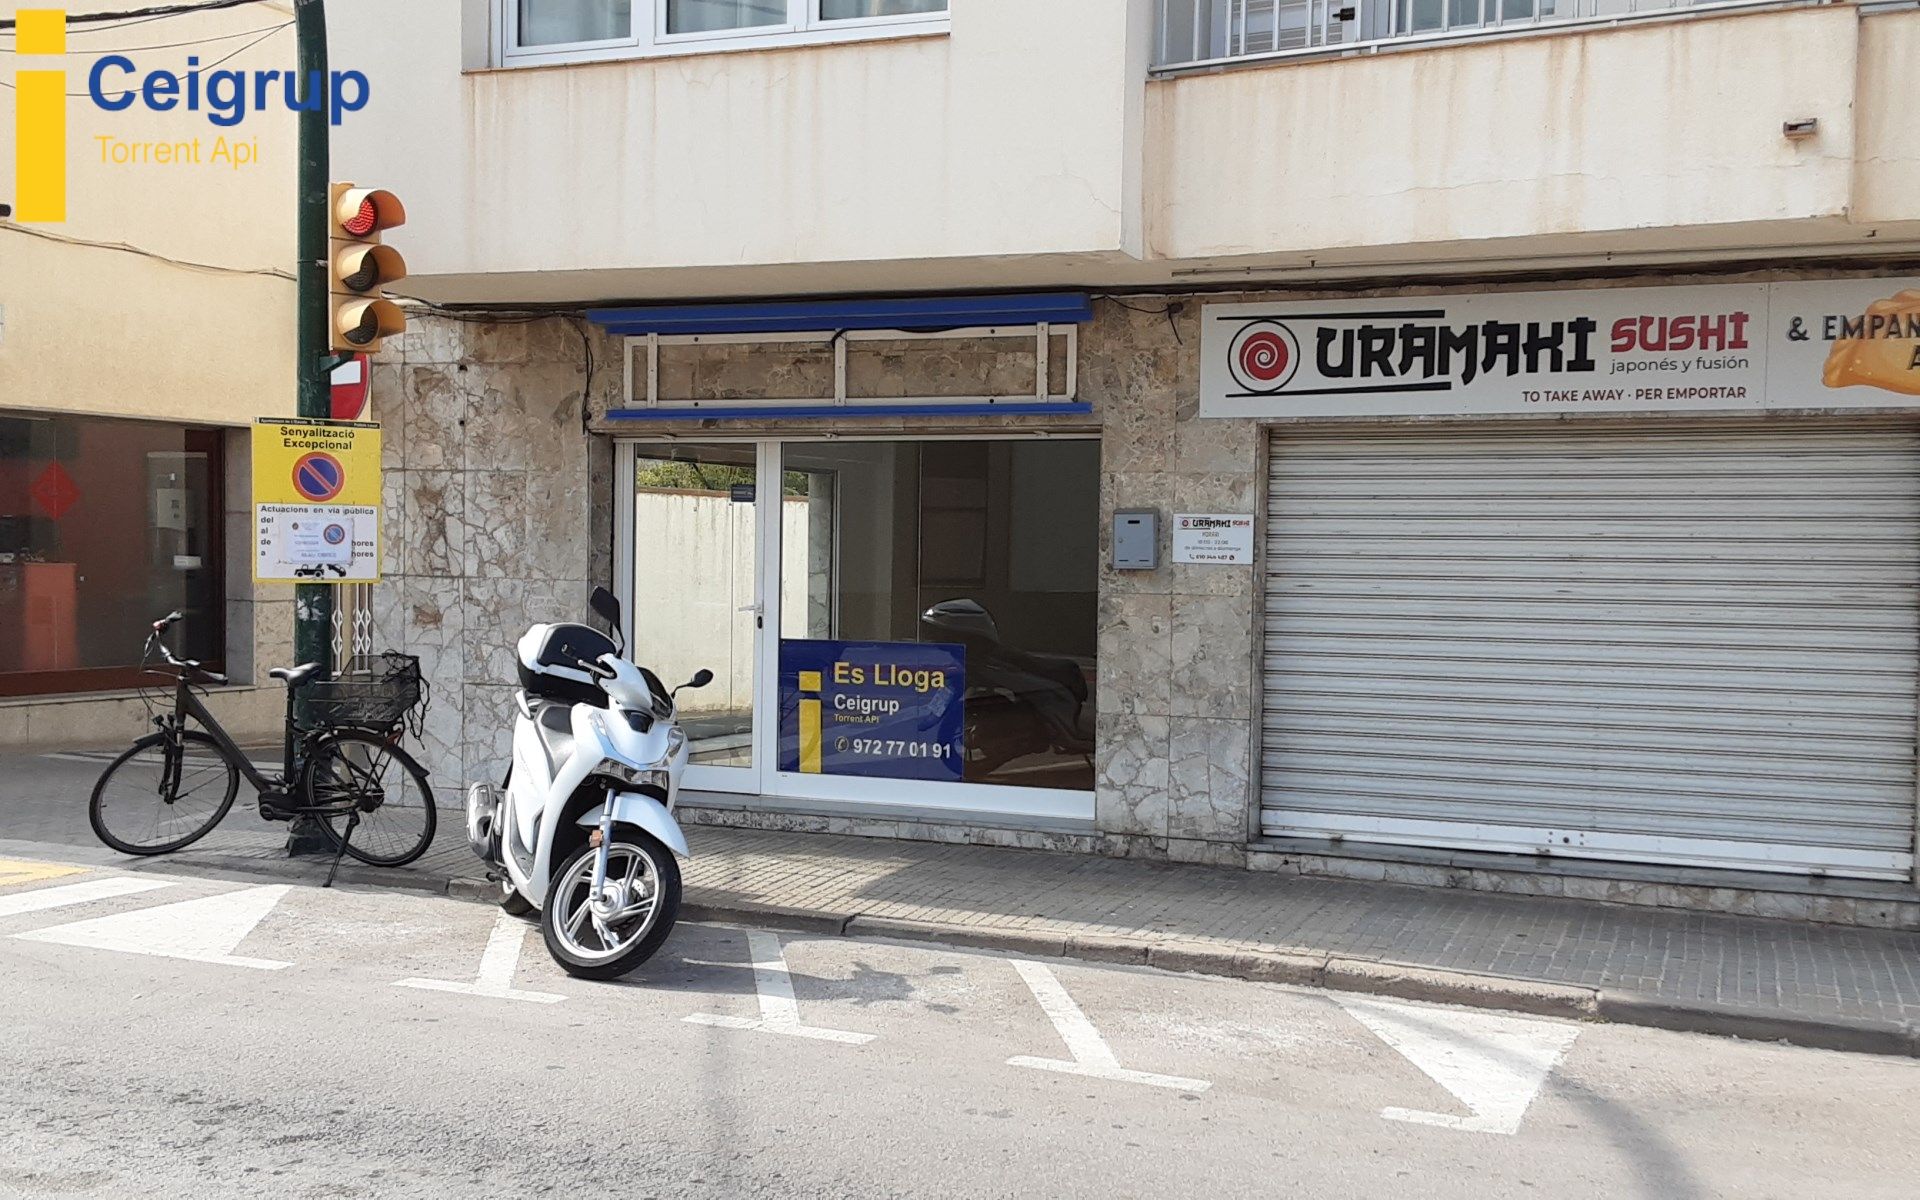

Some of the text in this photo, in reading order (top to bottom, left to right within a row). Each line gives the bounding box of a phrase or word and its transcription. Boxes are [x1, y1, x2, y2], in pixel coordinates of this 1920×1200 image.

[1786, 315, 1810, 341] &
[1316, 311, 1750, 386] URAMAKI SUSHI
[1609, 355, 1749, 375] japonés y fusión
[1522, 386, 1747, 403] TO TAKE AWAY PER EMPORTAR
[280, 426, 355, 439] Senyalització
[283, 438, 352, 450] Excepcional
[260, 505, 309, 514] Actuacions
[343, 507, 374, 515] pública
[1192, 519, 1231, 528] URAMAKI
[834, 661, 945, 693] Es Lloga
[834, 693, 900, 716] Ceigrup
[834, 713, 862, 723] Torrent
[853, 738, 951, 759] 972 77 01 91
